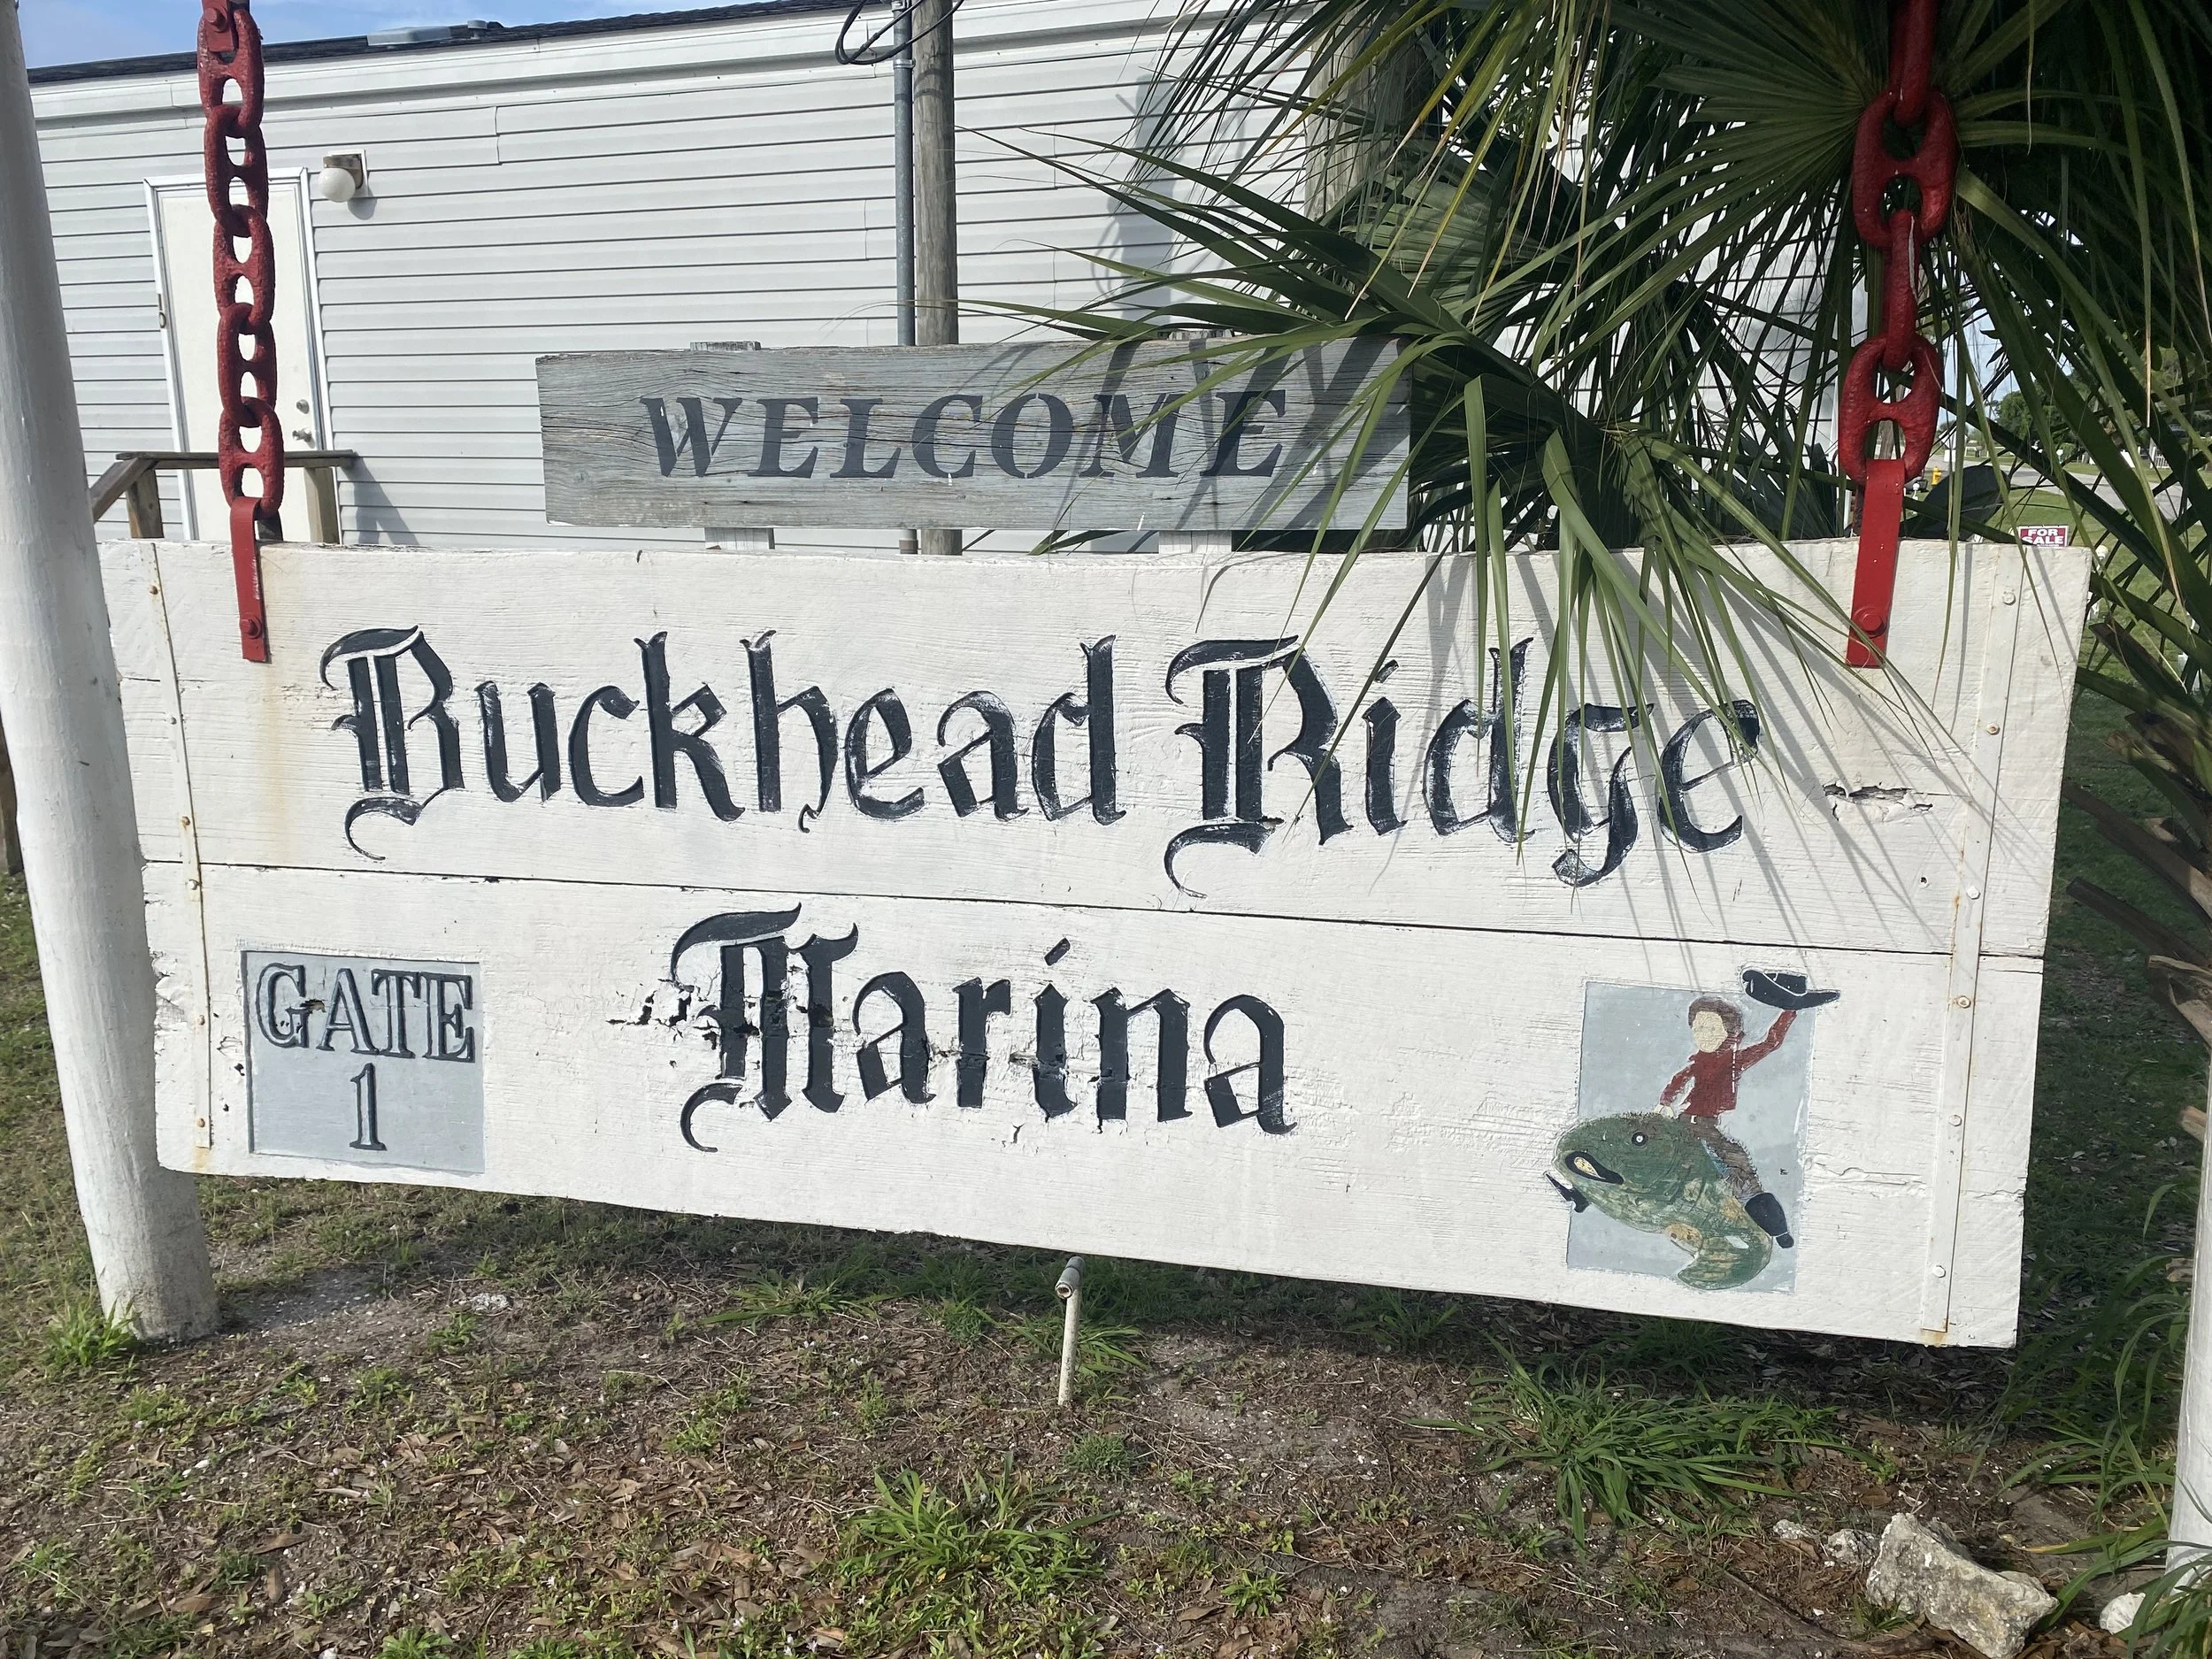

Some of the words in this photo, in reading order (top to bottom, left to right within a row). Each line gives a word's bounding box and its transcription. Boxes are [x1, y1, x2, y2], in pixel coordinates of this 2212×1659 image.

[641, 390, 1286, 479] WELCOME
[319, 625, 1125, 860] Buckhead
[1164, 634, 1760, 898] Ridge
[256, 962, 475, 1063] GATE
[670, 902, 1298, 1154] Marina
[349, 1062, 388, 1150] 1
